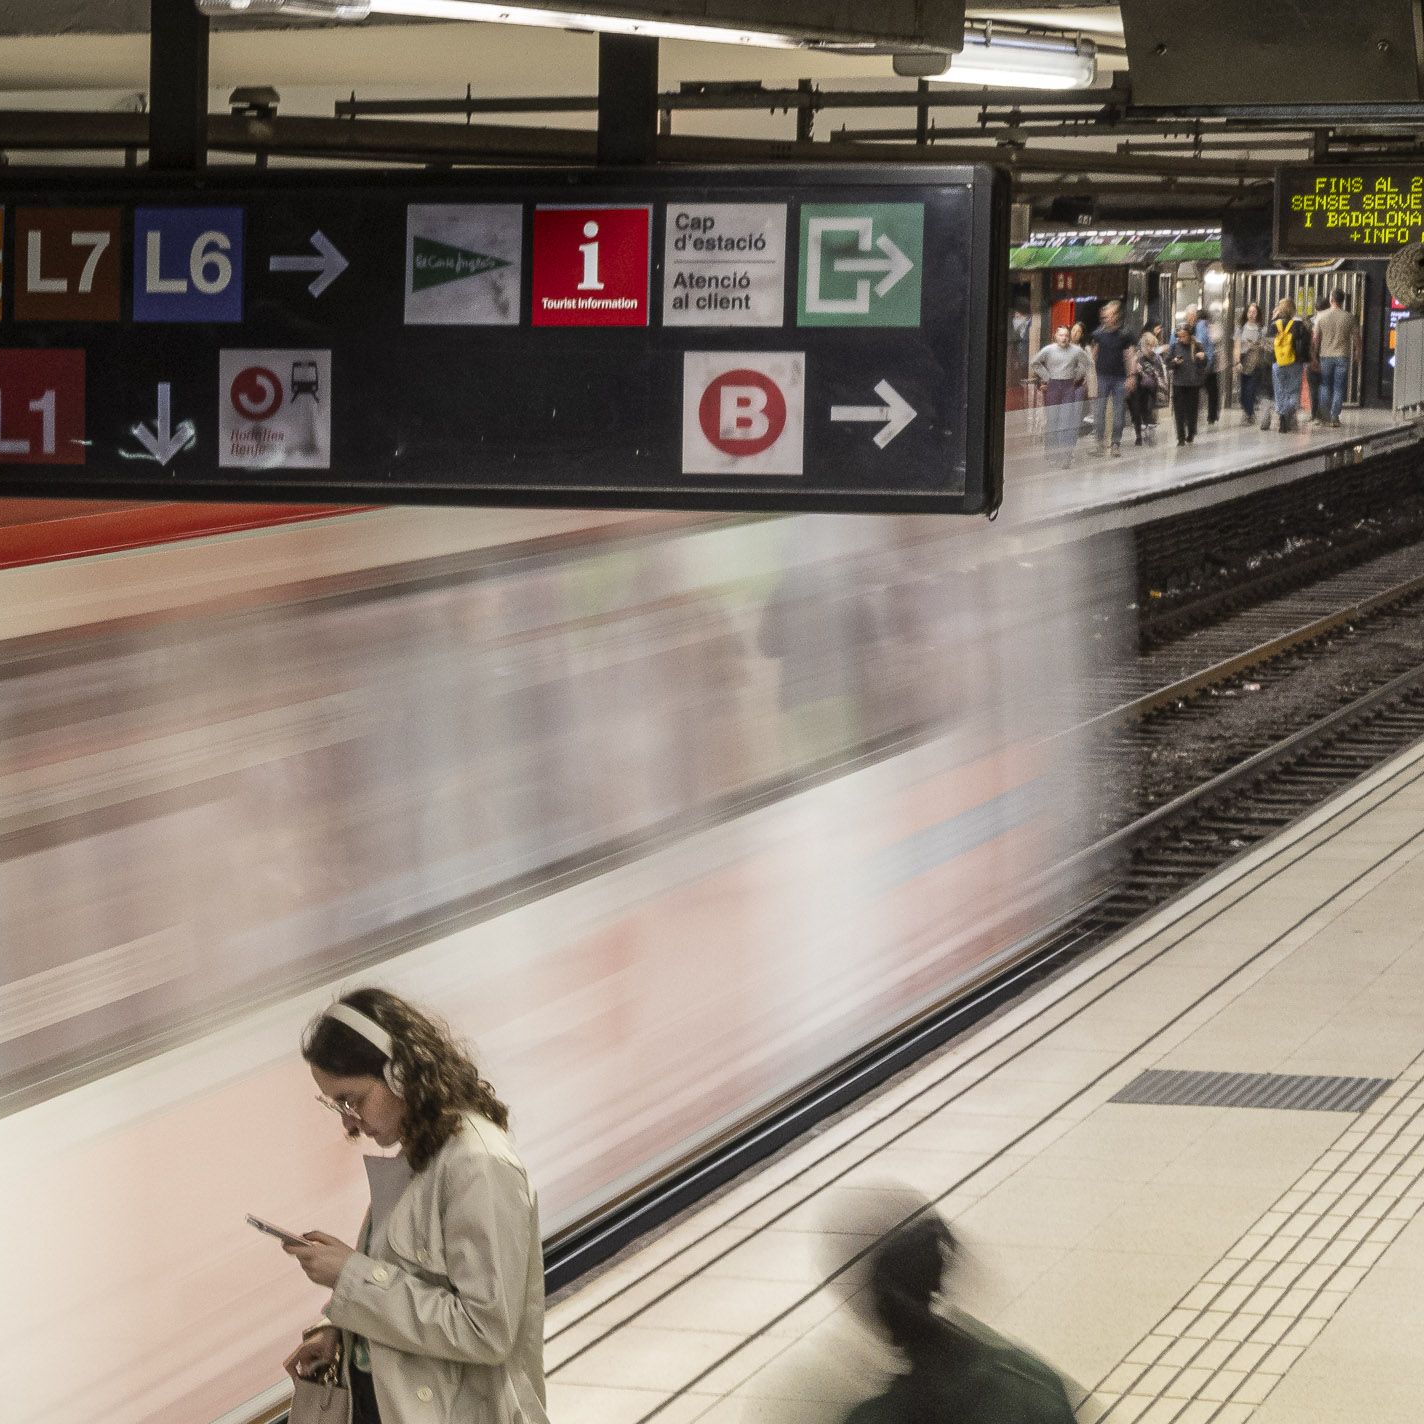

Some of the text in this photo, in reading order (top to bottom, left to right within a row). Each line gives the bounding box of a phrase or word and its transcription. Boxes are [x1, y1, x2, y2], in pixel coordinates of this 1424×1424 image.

[1315, 177, 1363, 193] FINS
[1375, 177, 1399, 193] AL
[1290, 193, 1423, 211] SENSE SERVE
[675, 213, 716, 234] Cap
[1304, 210, 1423, 228] I BADALONA
[674, 233, 767, 251] d'estació
[1349, 228, 1410, 244] +INFO
[27, 229, 111, 293] L7
[146, 229, 233, 294] L6
[672, 271, 752, 290] Atenció
[541, 297, 639, 310] Tourist Information
[671, 292, 752, 310] al client
[719, 385, 771, 441] B
